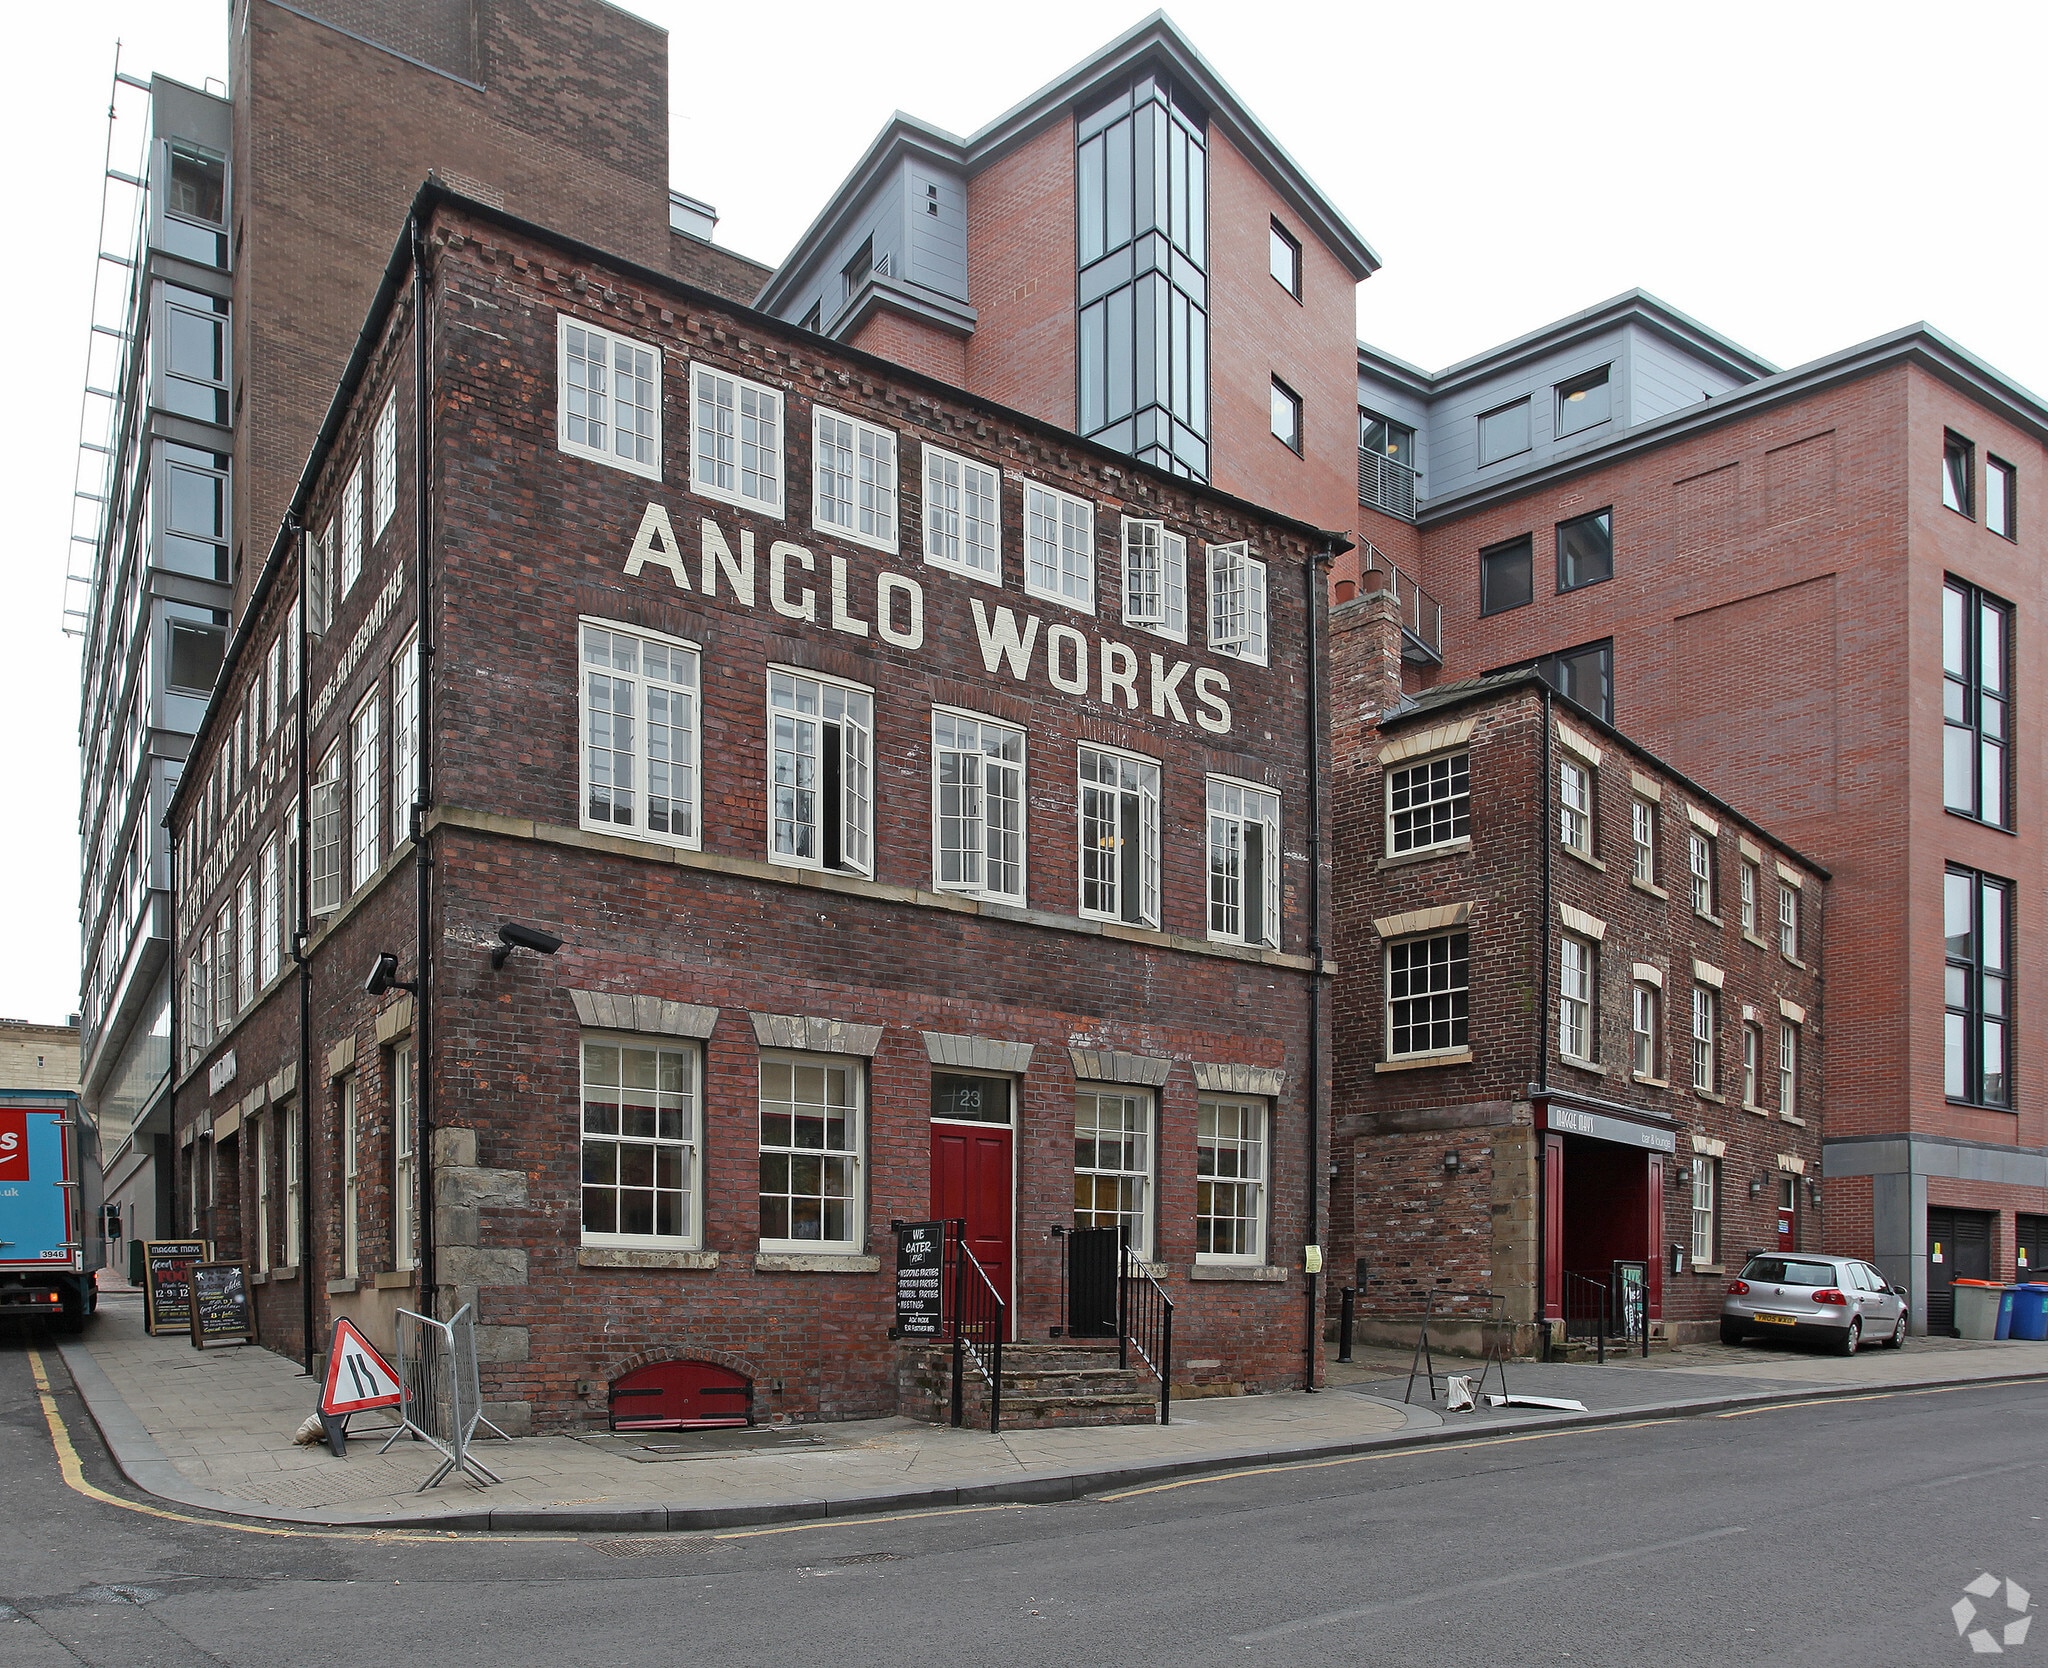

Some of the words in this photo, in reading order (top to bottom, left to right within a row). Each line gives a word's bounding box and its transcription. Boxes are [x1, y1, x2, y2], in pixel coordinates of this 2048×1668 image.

[622, 501, 925, 651] ANGLO
[969, 597, 1233, 735] WORKS
[336, 558, 405, 693] SILVERSMITHS
[202, 791, 249, 905] TRICKETT
[250, 785, 258, 830] &
[960, 1089, 980, 1108] 23
[1650, 1134, 1655, 1145] &
[1655, 1135, 1671, 1149] lounge
[0, 1187, 19, 1197] .uk
[912, 1228, 925, 1240] WE
[42, 1250, 65, 1258] 3946
[905, 1241, 931, 1254] CATER
[911, 1253, 923, 1263] FOR
[157, 1270, 188, 1283] FOO
[918, 1289, 939, 1299] PARTIES
